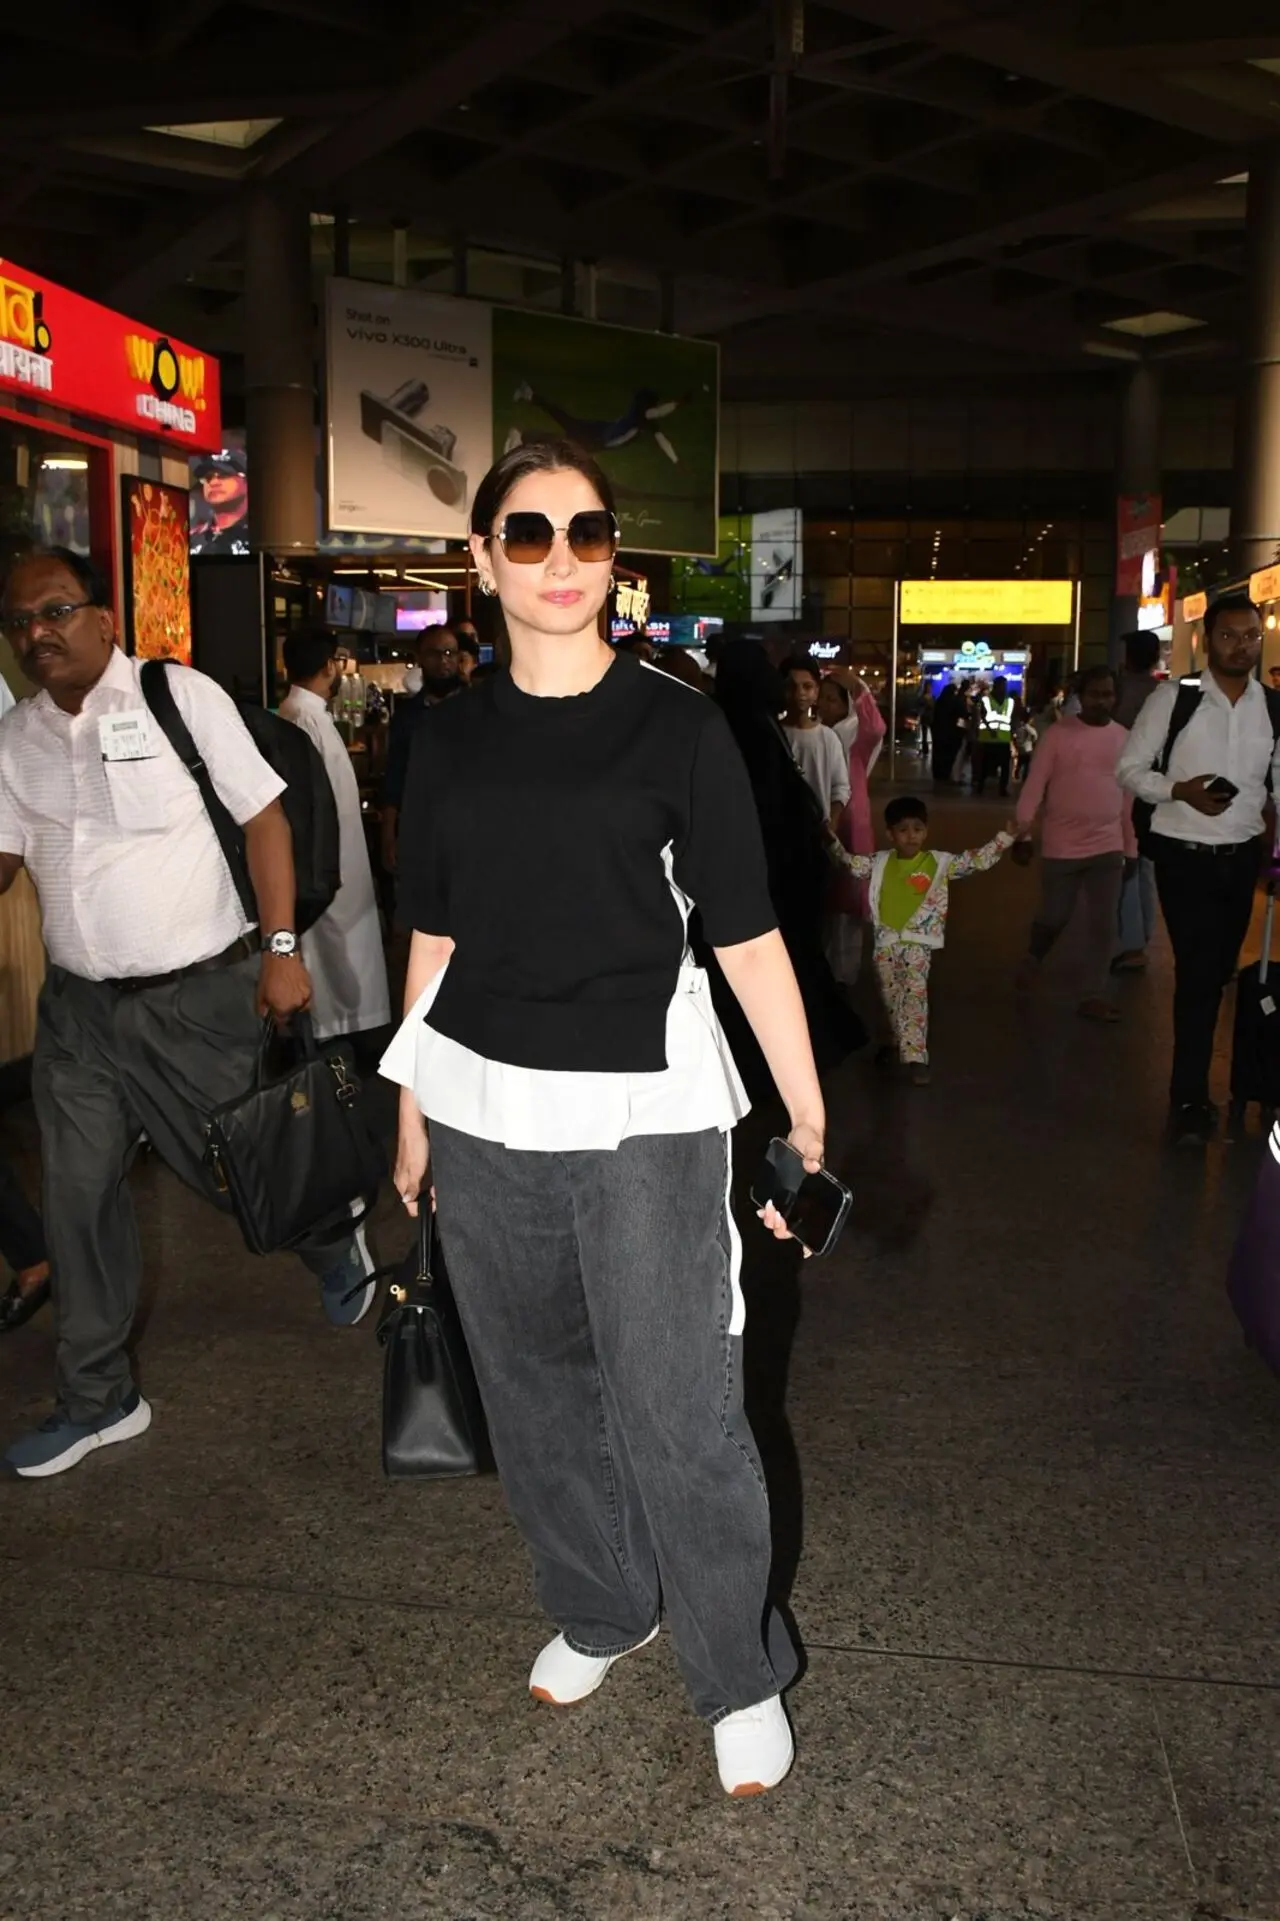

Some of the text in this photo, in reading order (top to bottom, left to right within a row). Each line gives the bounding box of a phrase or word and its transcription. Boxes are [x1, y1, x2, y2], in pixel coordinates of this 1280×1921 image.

[346, 307, 391, 326] Shot on
[346, 327, 467, 355] vivo X300 Ultra
[125, 334, 206, 411] WOW!
